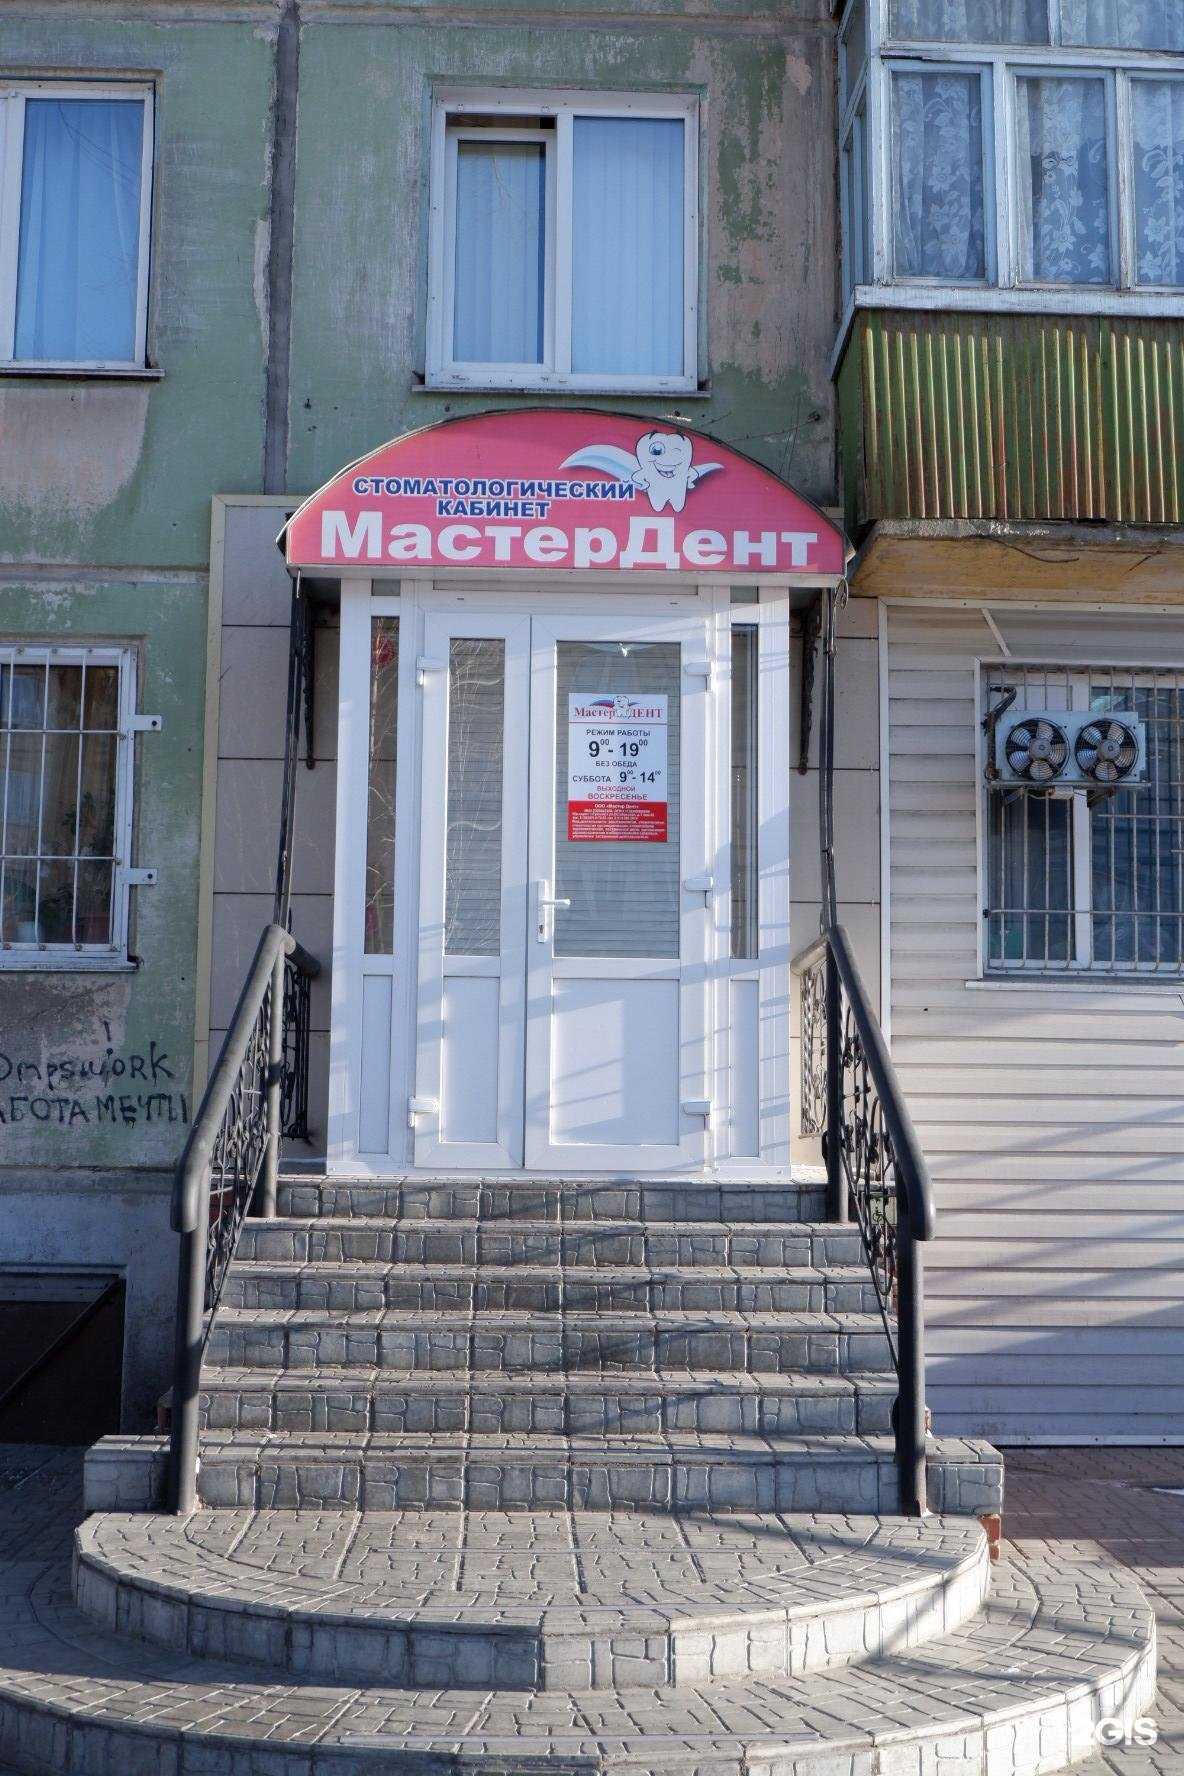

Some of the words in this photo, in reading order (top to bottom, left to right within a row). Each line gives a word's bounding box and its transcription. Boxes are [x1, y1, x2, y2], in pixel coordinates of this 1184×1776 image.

[353, 476, 636, 500] СТОМАТОЛОГИЧЕСКИЙ
[436, 499, 551, 519] КАБИНЕТ
[321, 510, 819, 569] МастерДент
[617, 729, 651, 737] РАБОТЫ
[572, 775, 612, 783] СУББОТА
